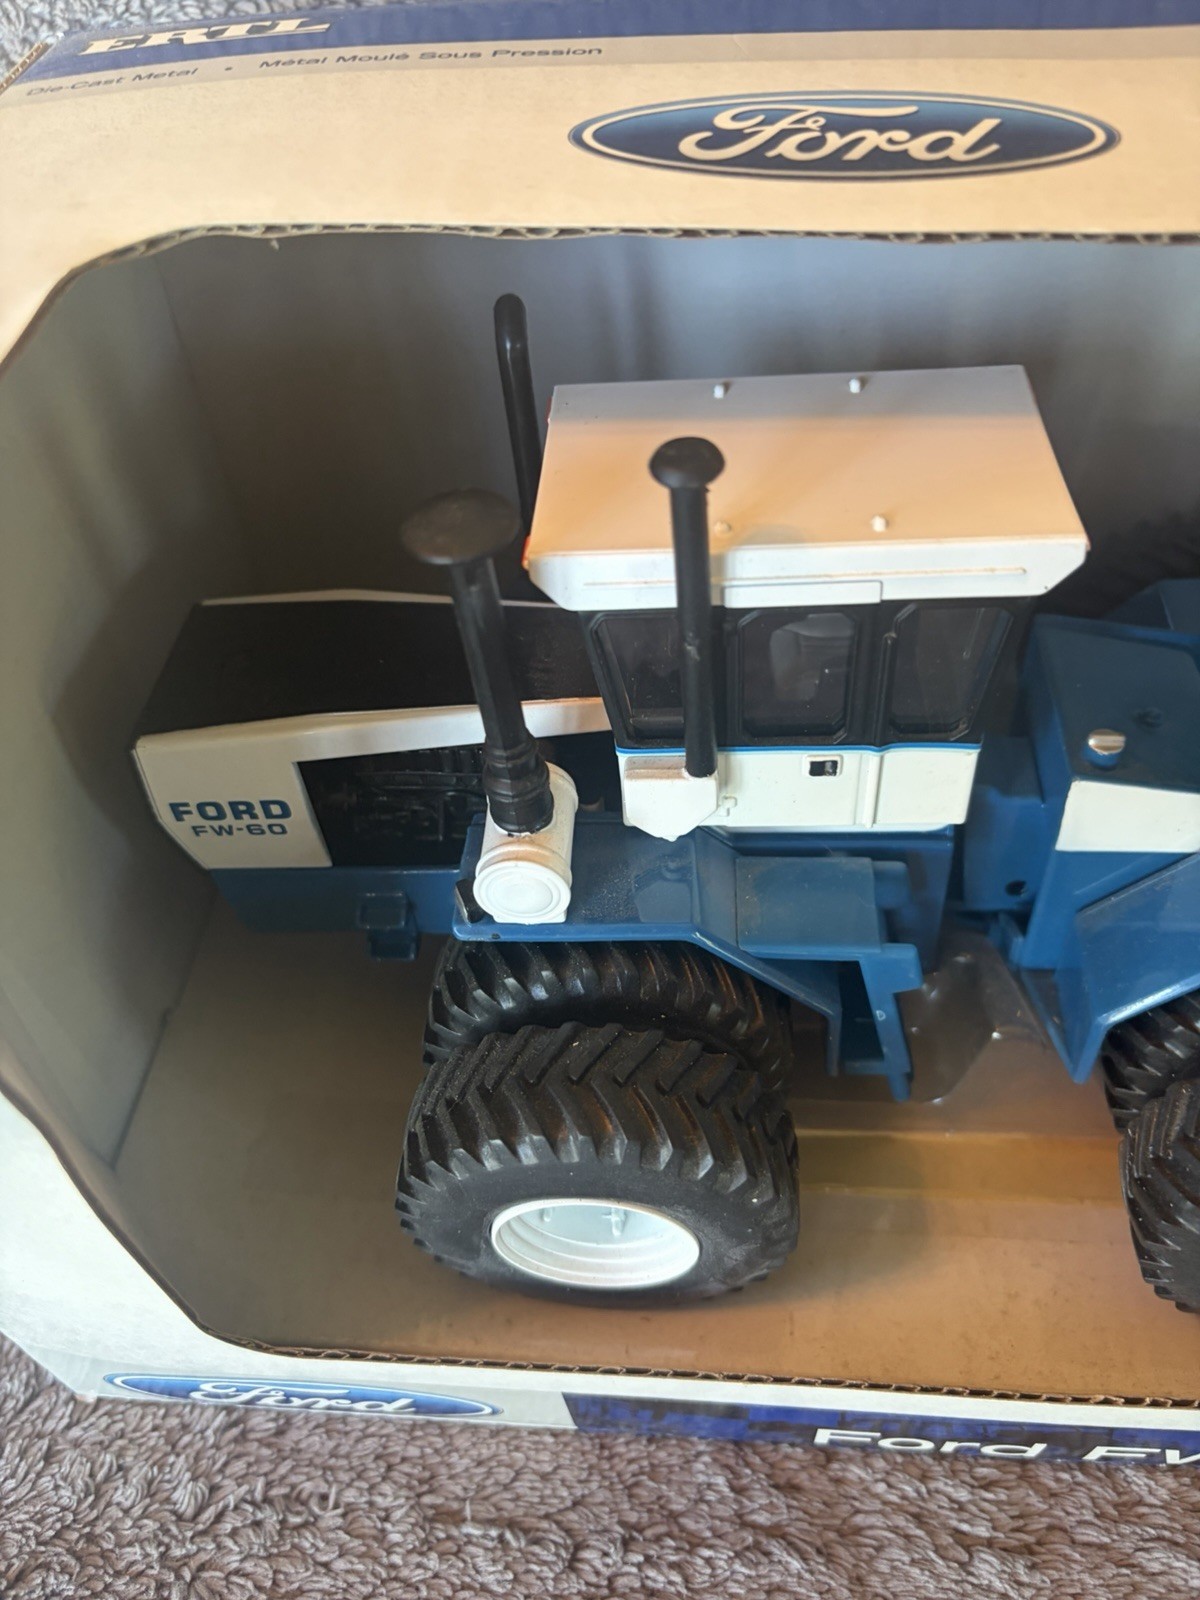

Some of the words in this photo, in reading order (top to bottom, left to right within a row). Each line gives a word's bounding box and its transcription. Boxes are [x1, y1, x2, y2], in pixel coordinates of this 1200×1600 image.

[79, 18, 331, 55] ERTL
[335, 53, 410, 64] Moulé
[418, 52, 482, 61] Sous
[491, 47, 604, 58] Pression
[26, 76, 125, 97] Die-Cast
[131, 67, 199, 83] Metal
[678, 104, 1001, 162] Ford
[169, 799, 292, 822] FORD
[191, 823, 288, 838] FW-60
[189, 1382, 417, 1414] Ford
[813, 1428, 1048, 1459] Ford
